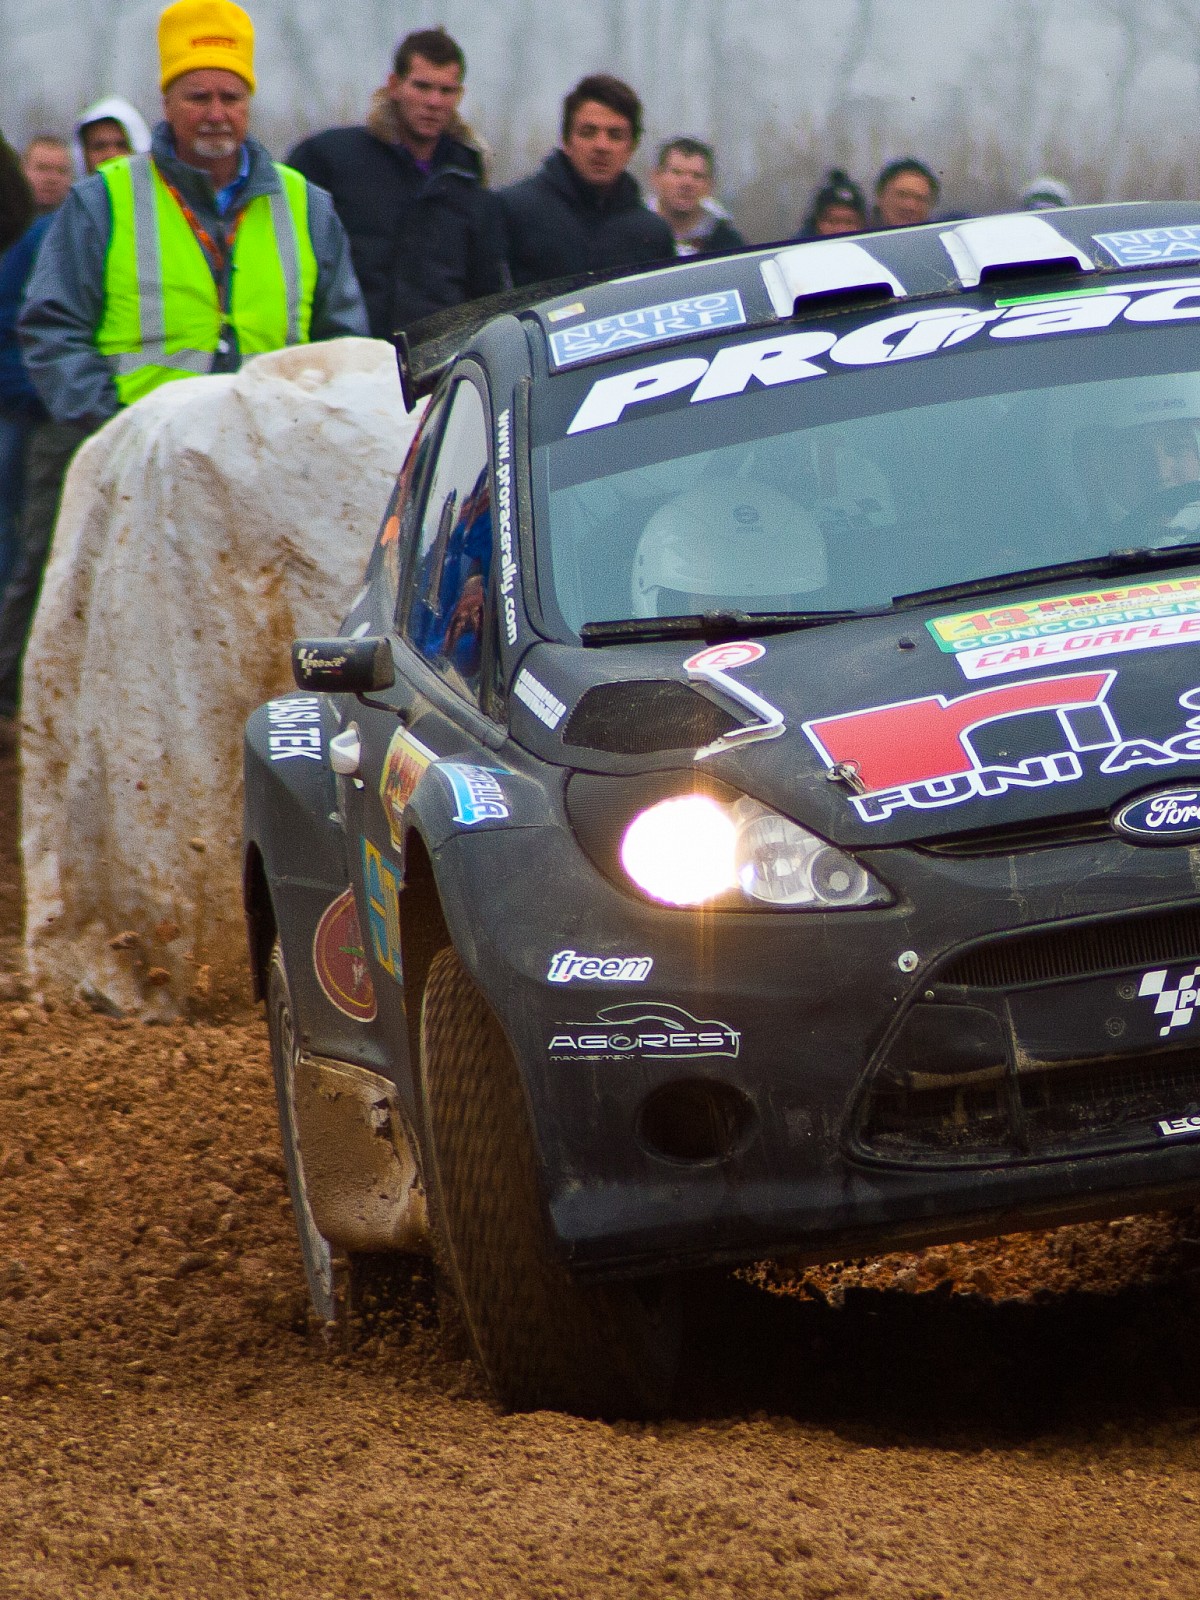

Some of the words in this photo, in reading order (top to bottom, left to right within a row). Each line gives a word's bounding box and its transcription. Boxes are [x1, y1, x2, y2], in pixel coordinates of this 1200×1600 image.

[561, 296, 728, 344] NEUTRO
[564, 307, 730, 358] SARF
[497, 408, 518, 646] www.proracerally.com
[847, 750, 1083, 823] FUNI
[549, 952, 653, 981] freem
[548, 1032, 742, 1051] AGOREST
